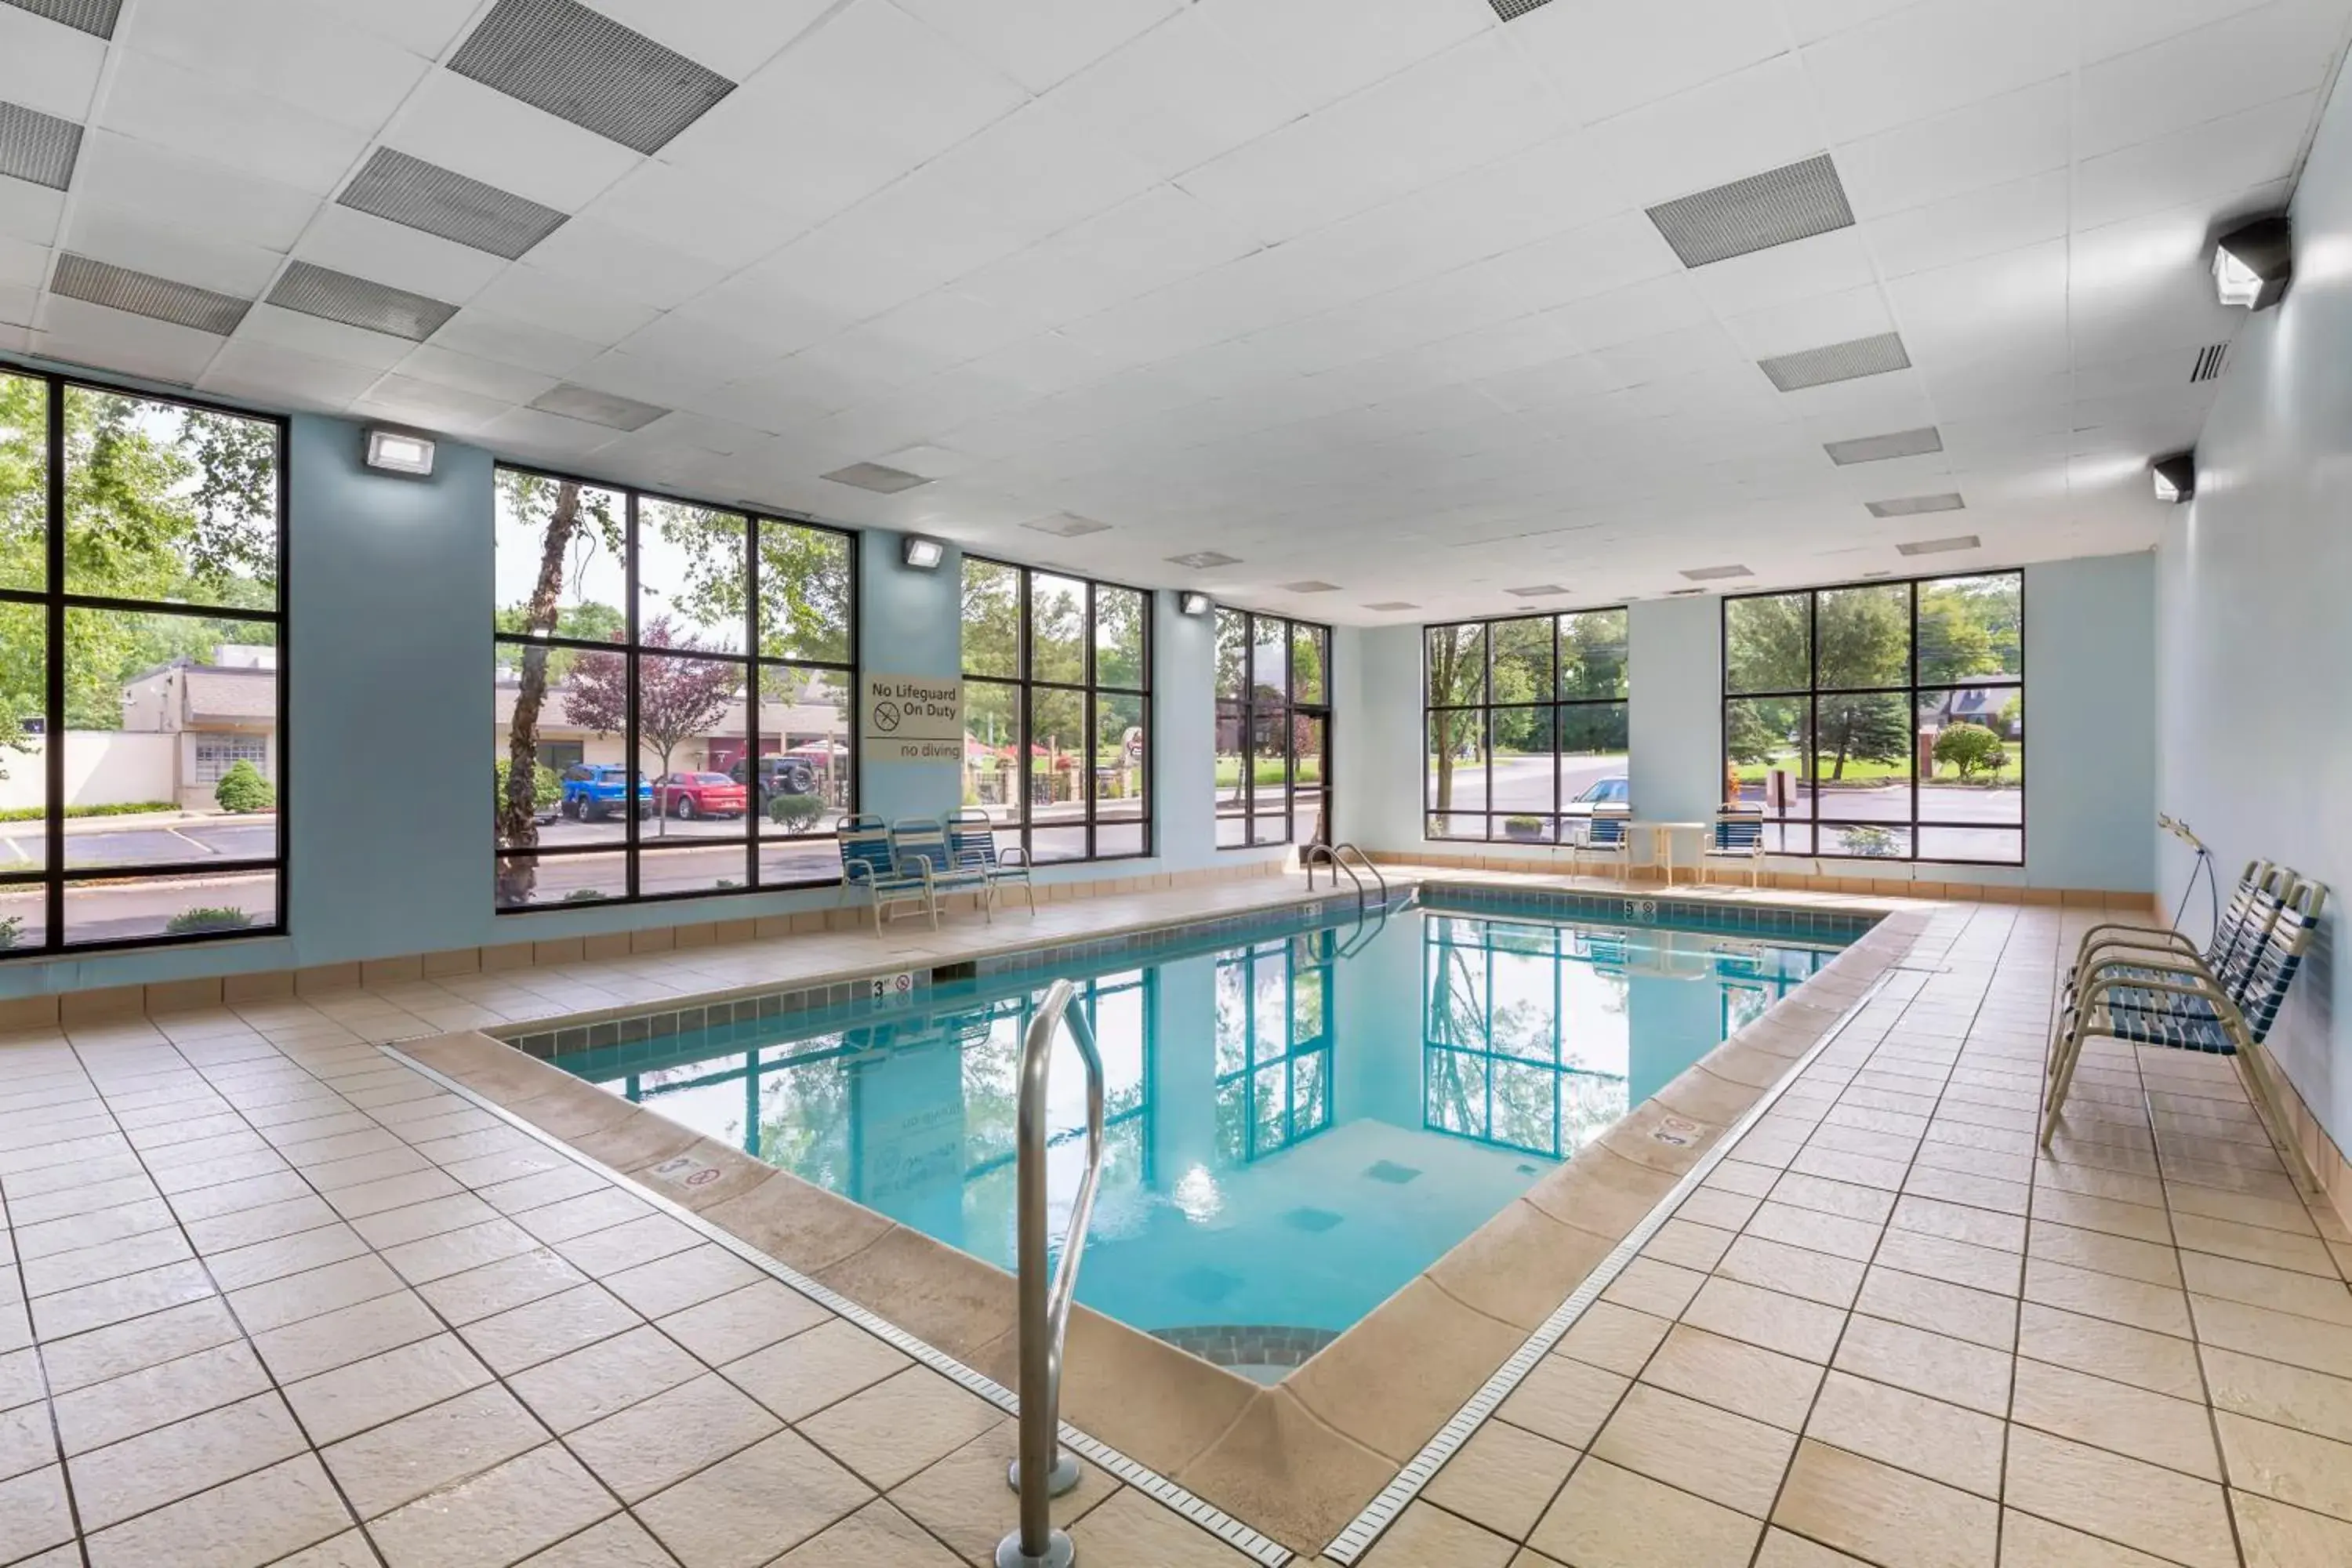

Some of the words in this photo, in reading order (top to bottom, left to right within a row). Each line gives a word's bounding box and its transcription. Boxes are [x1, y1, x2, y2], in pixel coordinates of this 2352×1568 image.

[873, 683, 891, 697] No
[896, 684, 956, 702] Lifeguard
[904, 702, 923, 716] On
[927, 704, 956, 720] Duty
[902, 745, 917, 757] no
[921, 744, 960, 760] diving
[874, 981, 884, 996] 3
